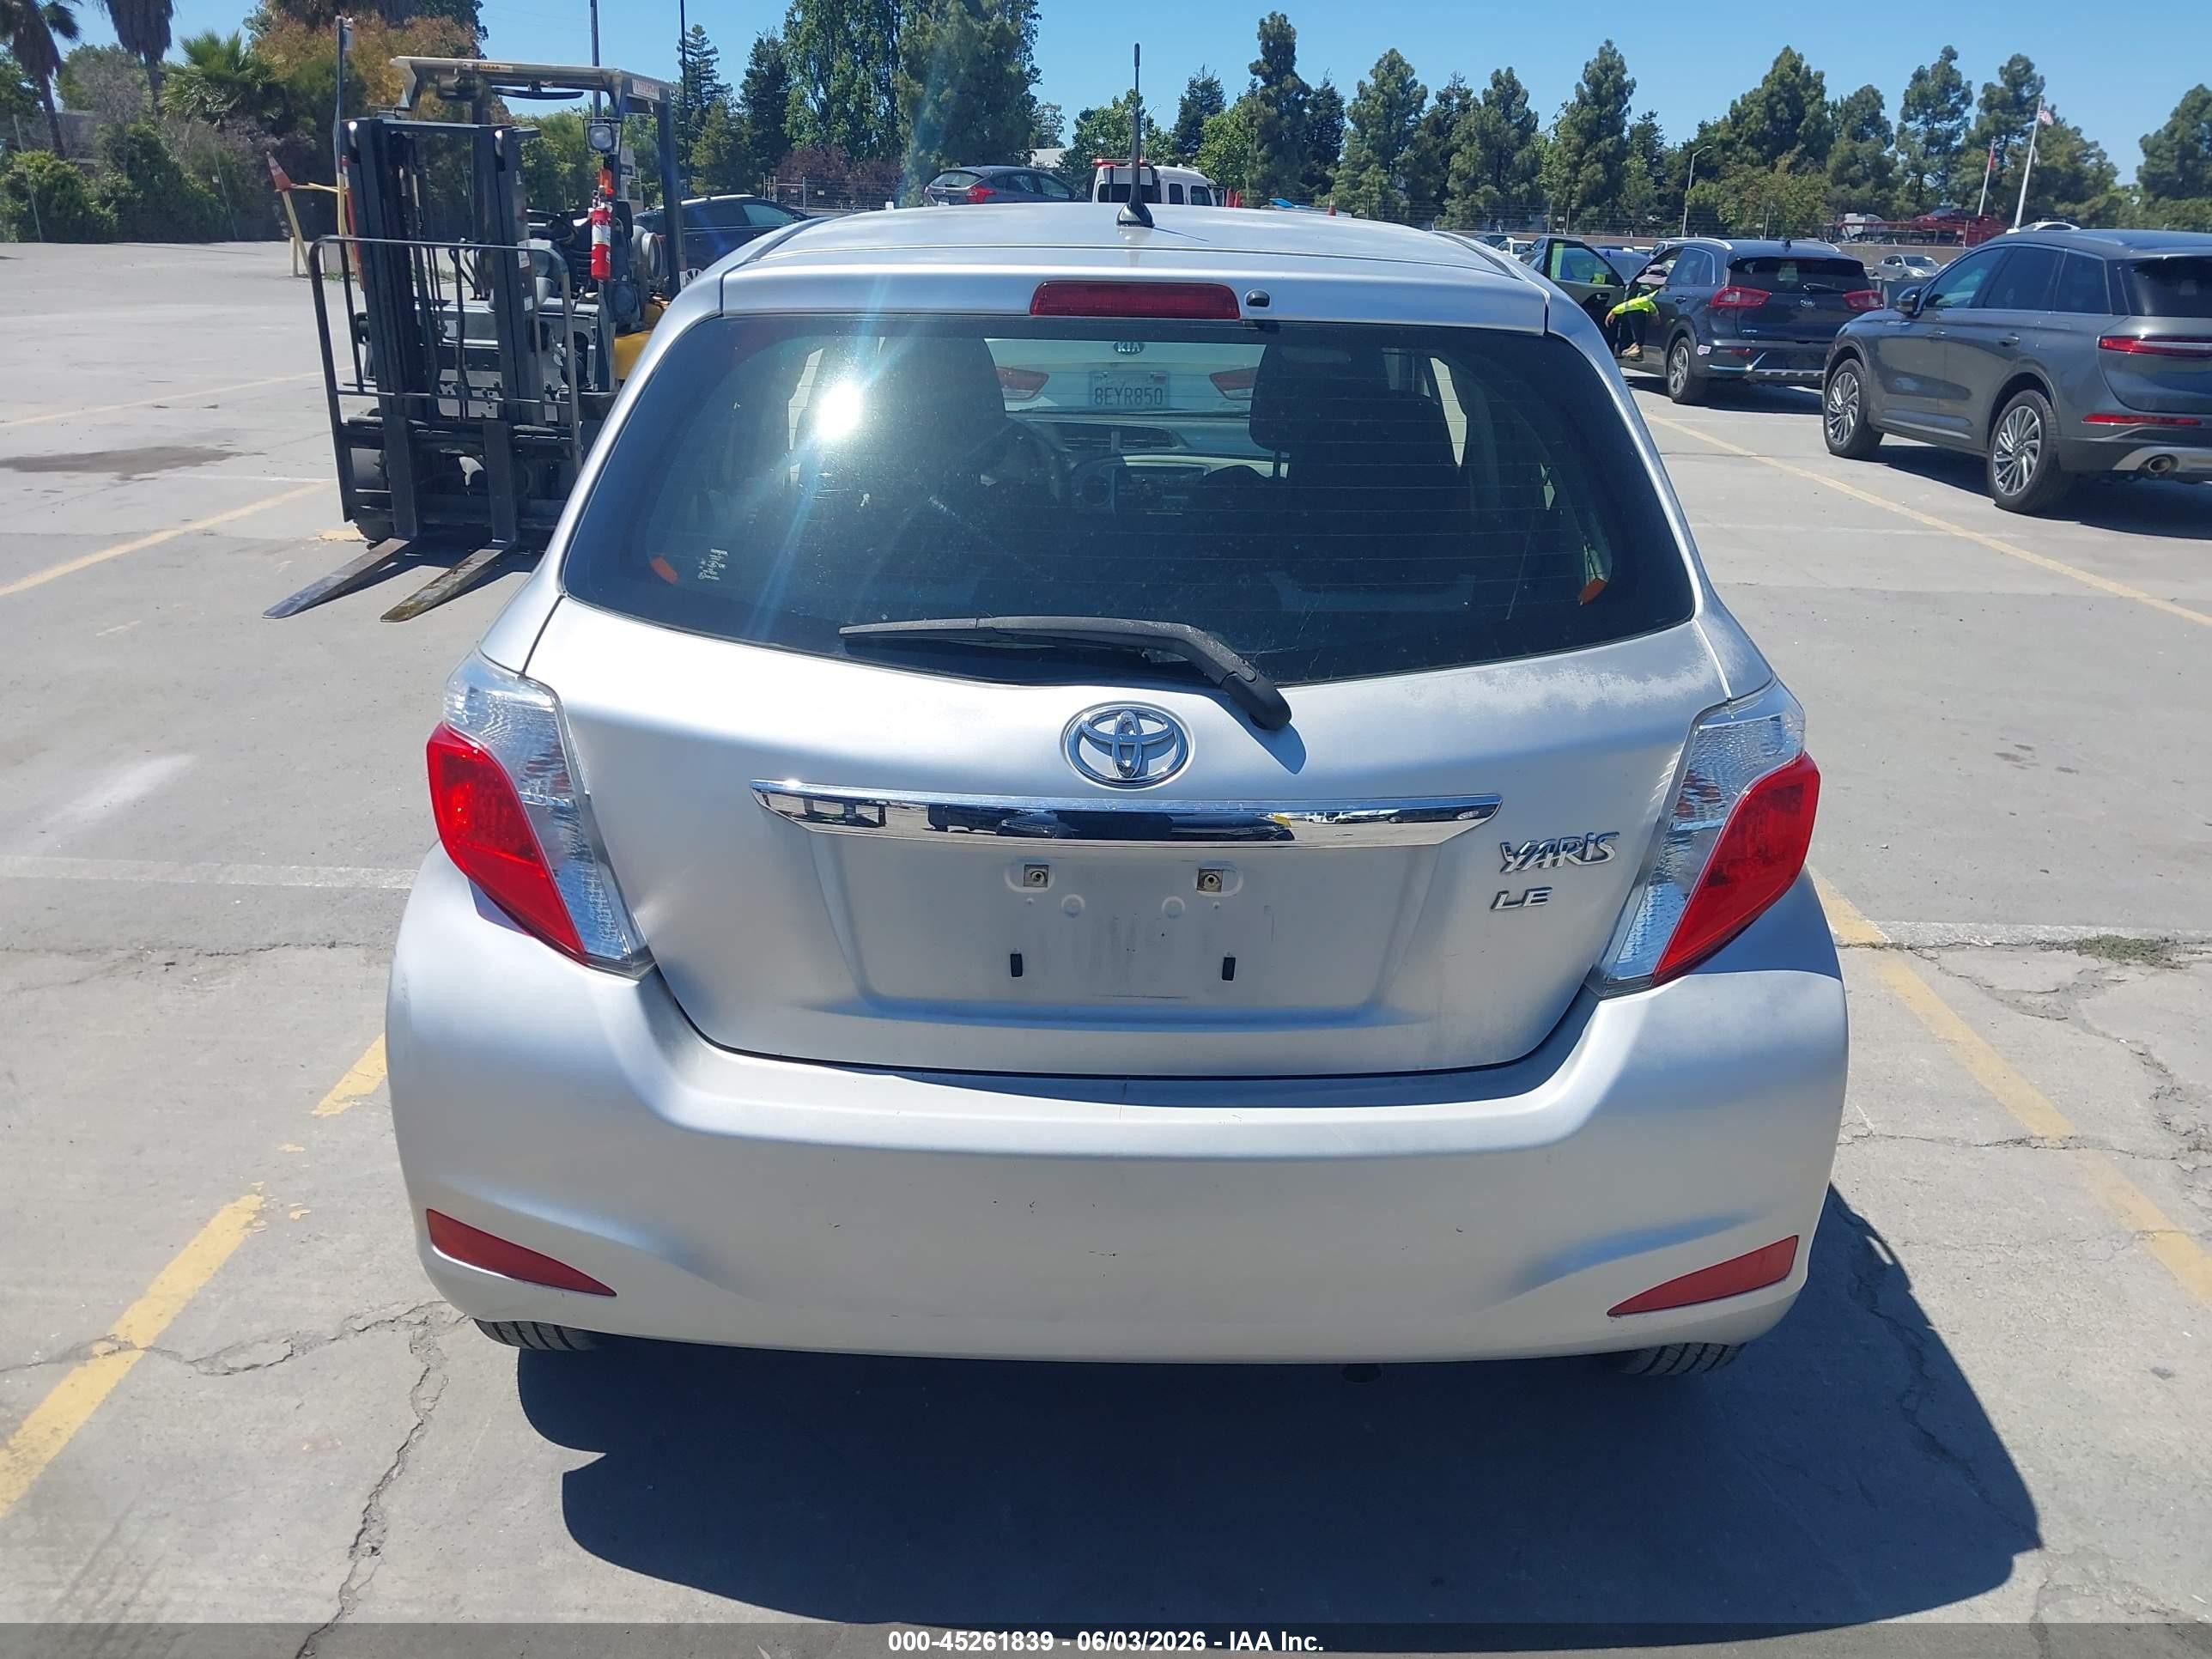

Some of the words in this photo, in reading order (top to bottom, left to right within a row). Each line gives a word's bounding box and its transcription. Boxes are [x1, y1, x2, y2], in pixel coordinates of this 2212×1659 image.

[1117, 342, 1141, 353] KIA
[1094, 387, 1164, 405] 8EYR850
[1490, 886, 1553, 910] LE
